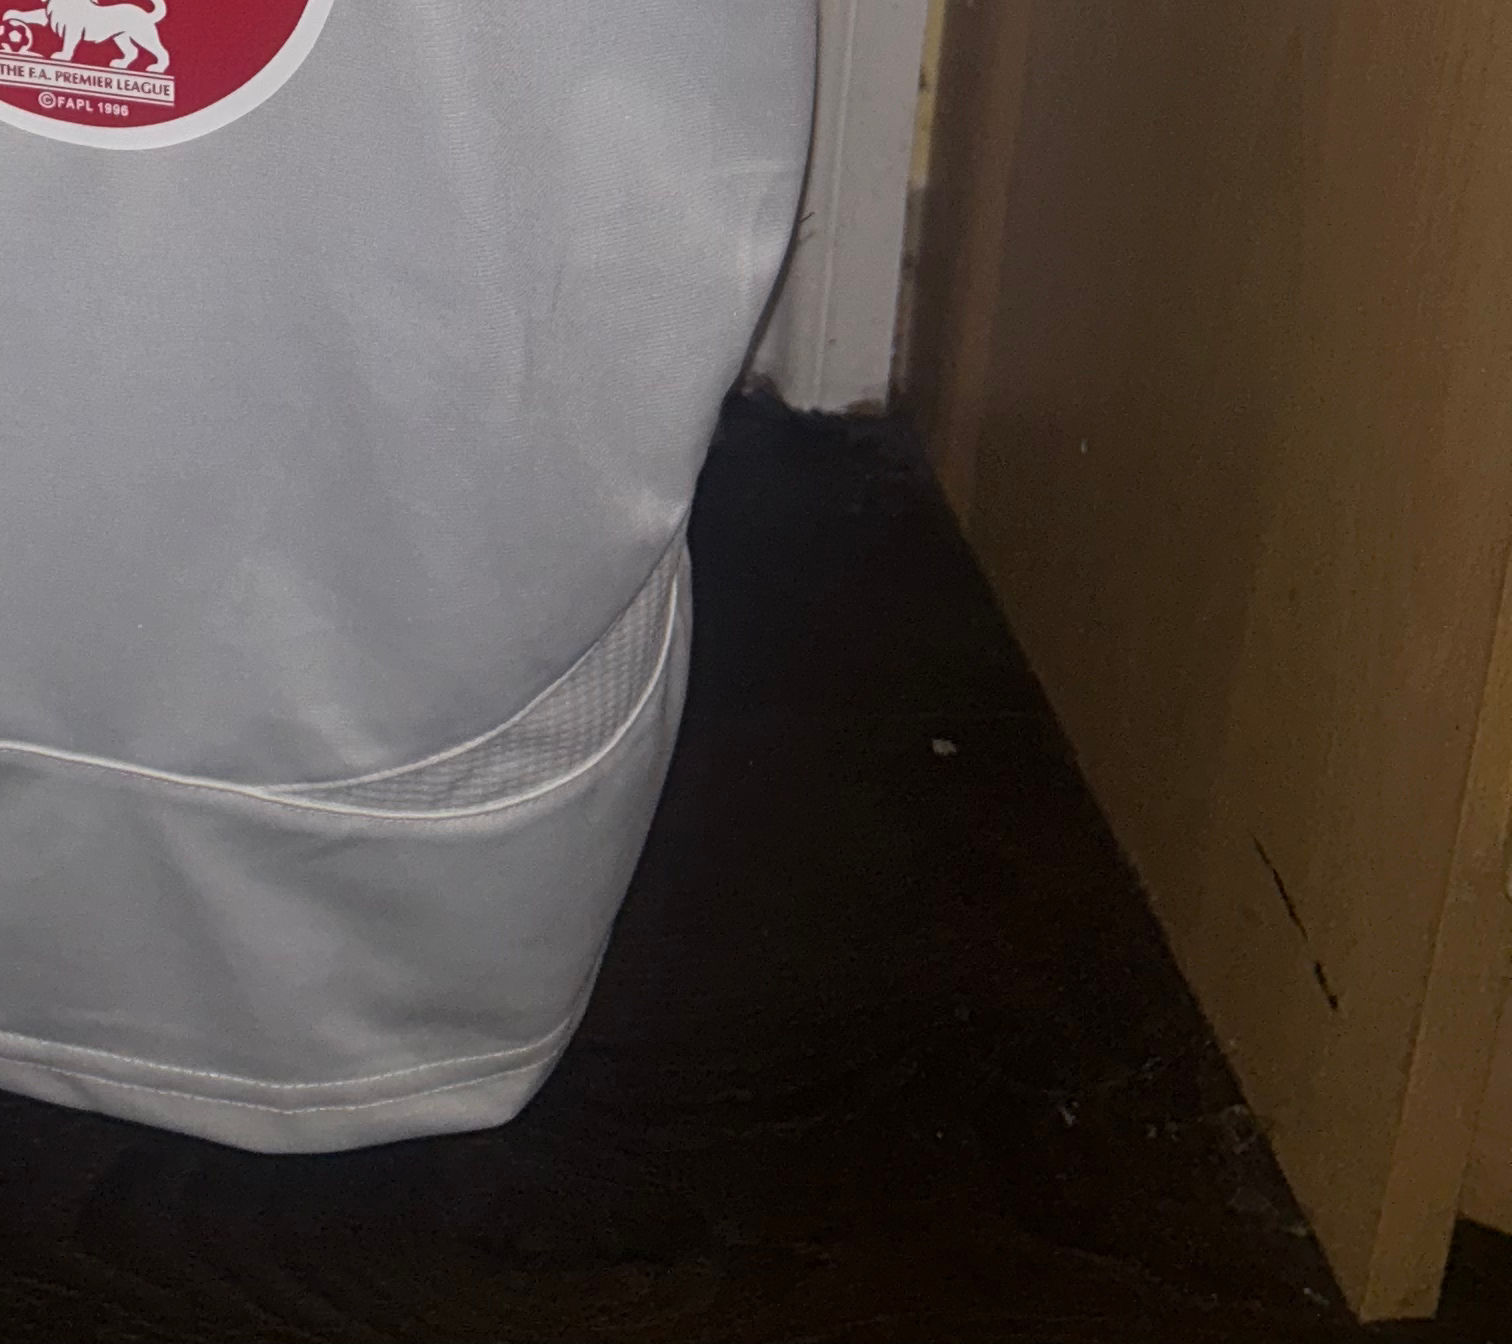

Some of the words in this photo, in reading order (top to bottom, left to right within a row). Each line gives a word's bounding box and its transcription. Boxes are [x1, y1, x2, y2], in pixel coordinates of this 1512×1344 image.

[28, 68, 52, 80] F.A.
[55, 70, 113, 90] PREMIER
[117, 77, 171, 97] LEAGUE
